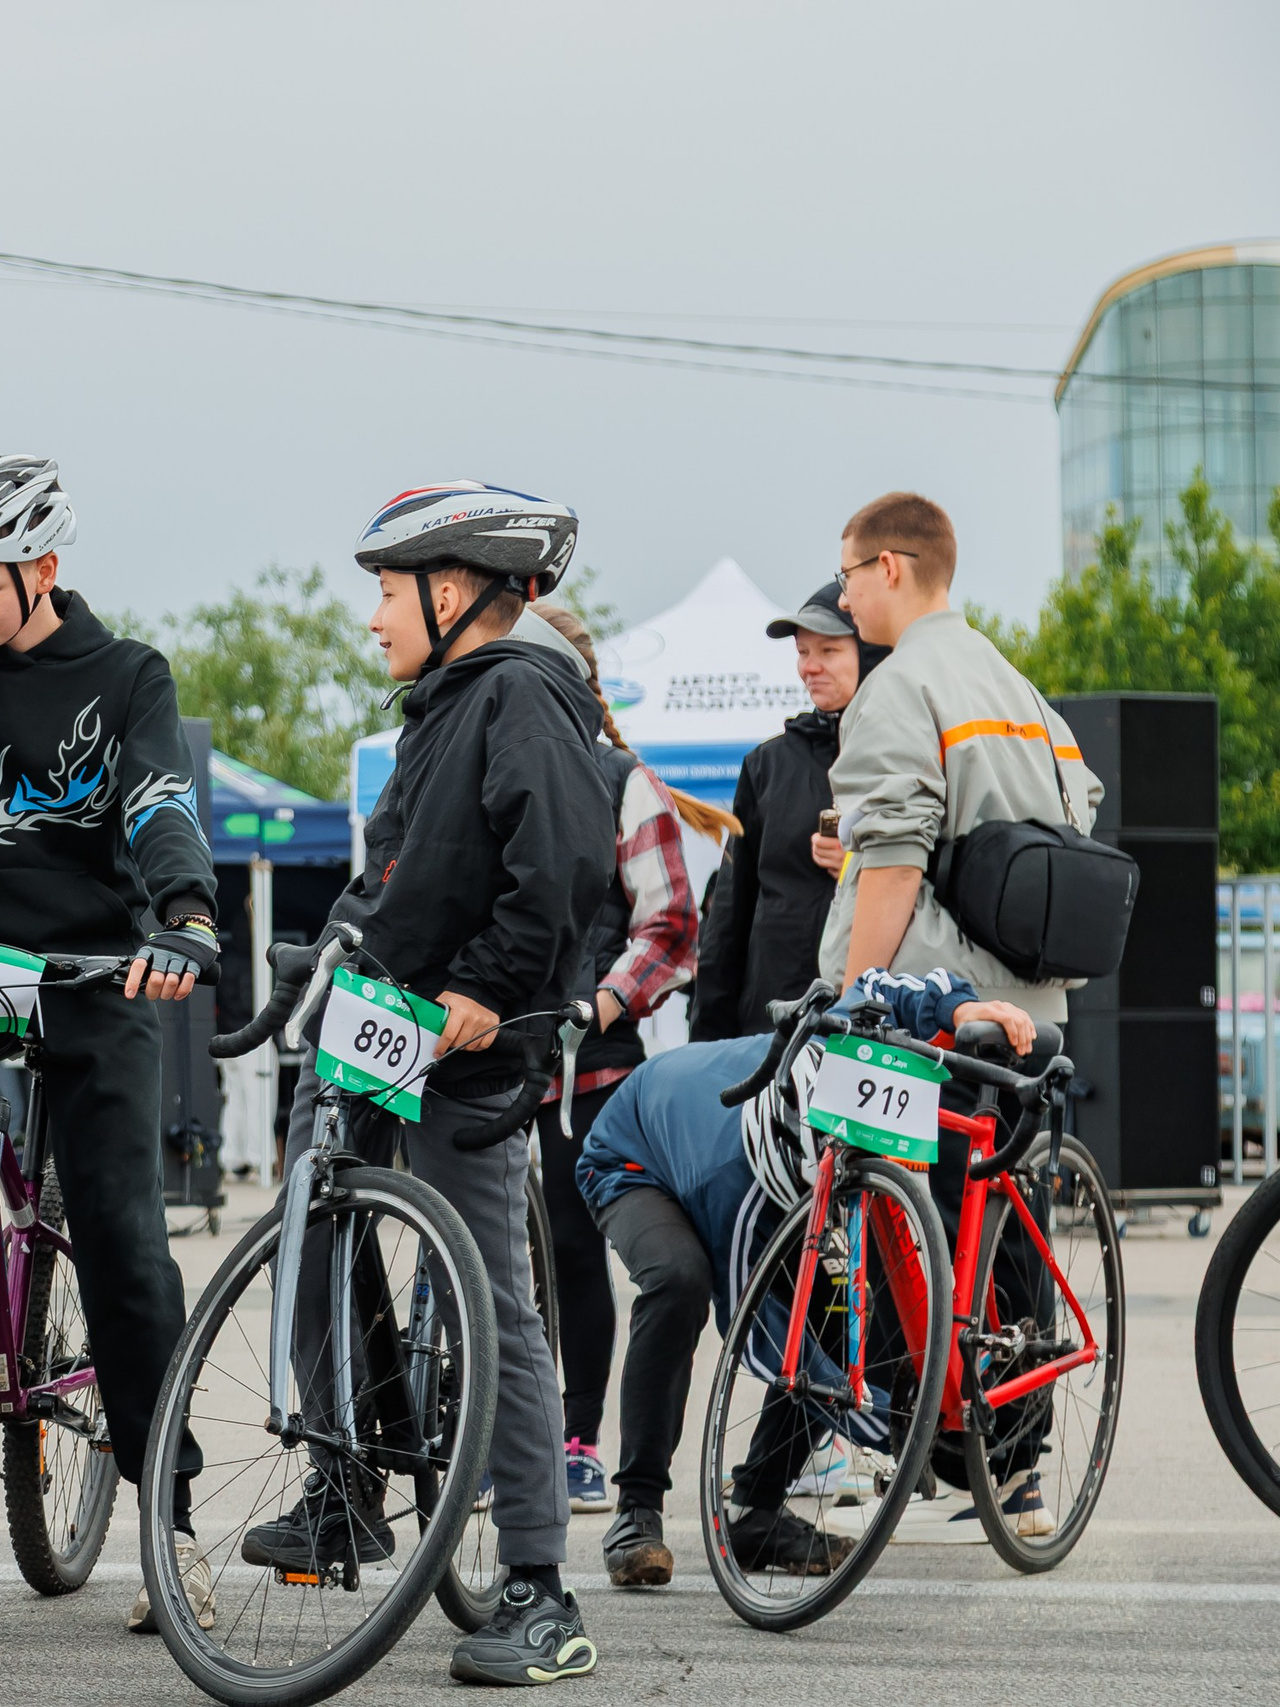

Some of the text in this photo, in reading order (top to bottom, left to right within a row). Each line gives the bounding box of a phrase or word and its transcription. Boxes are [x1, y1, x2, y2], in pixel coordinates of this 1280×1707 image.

[421, 507, 494, 531] КАТЮША
[505, 516, 557, 528] LAZER
[354, 1019, 407, 1067] 898
[857, 1078, 909, 1119] 919
